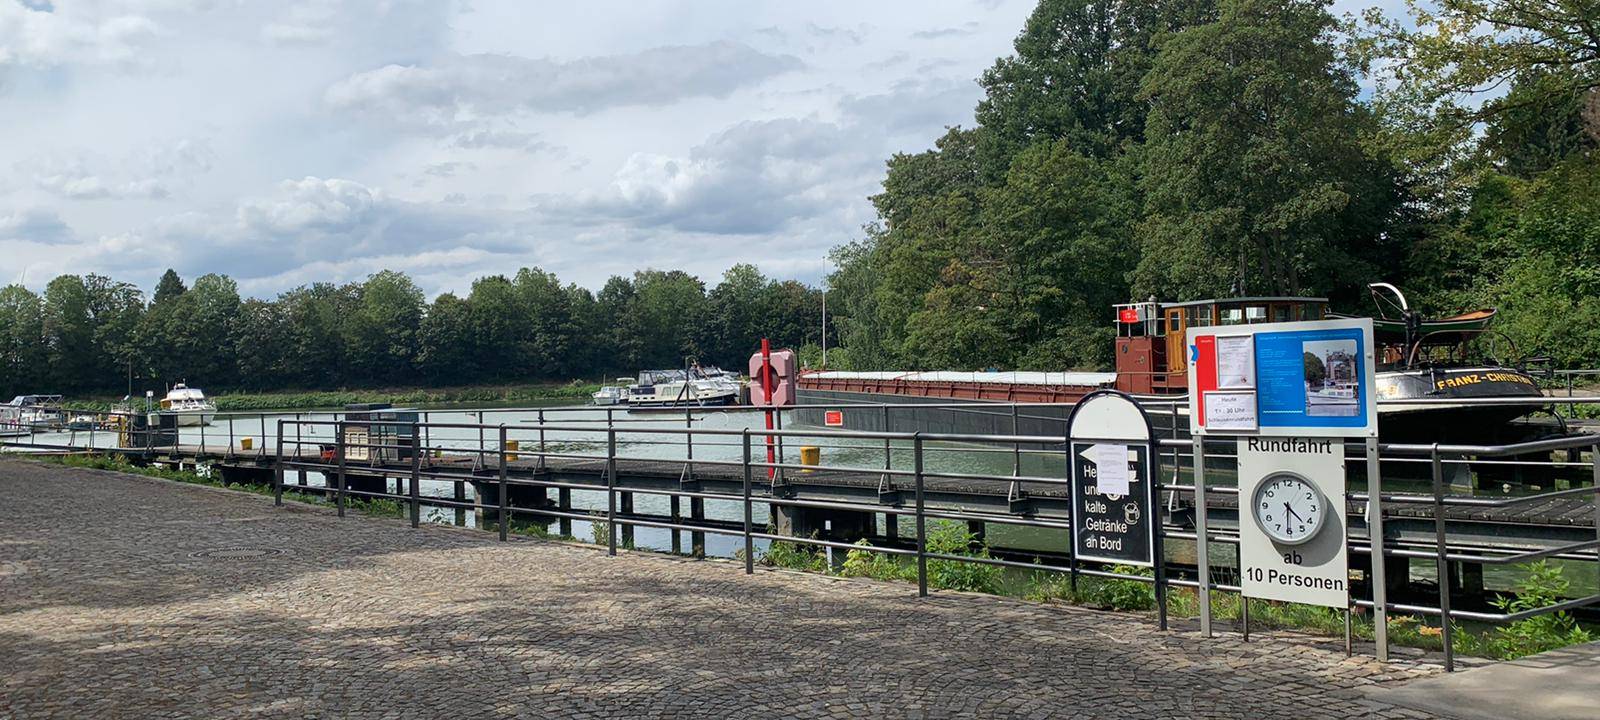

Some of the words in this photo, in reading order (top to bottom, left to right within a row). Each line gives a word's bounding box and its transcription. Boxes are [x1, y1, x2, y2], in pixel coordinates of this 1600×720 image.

[1248, 436, 1332, 454] Rundfahrt
[1083, 465, 1097, 478] He
[1085, 499, 1107, 514] kalte
[1085, 517, 1128, 533] Getränke
[1086, 537, 1098, 548] an
[1100, 536, 1122, 551] Bord
[1284, 550, 1302, 565] ab
[1246, 567, 1263, 582] 10
[1268, 569, 1344, 591] Personen
